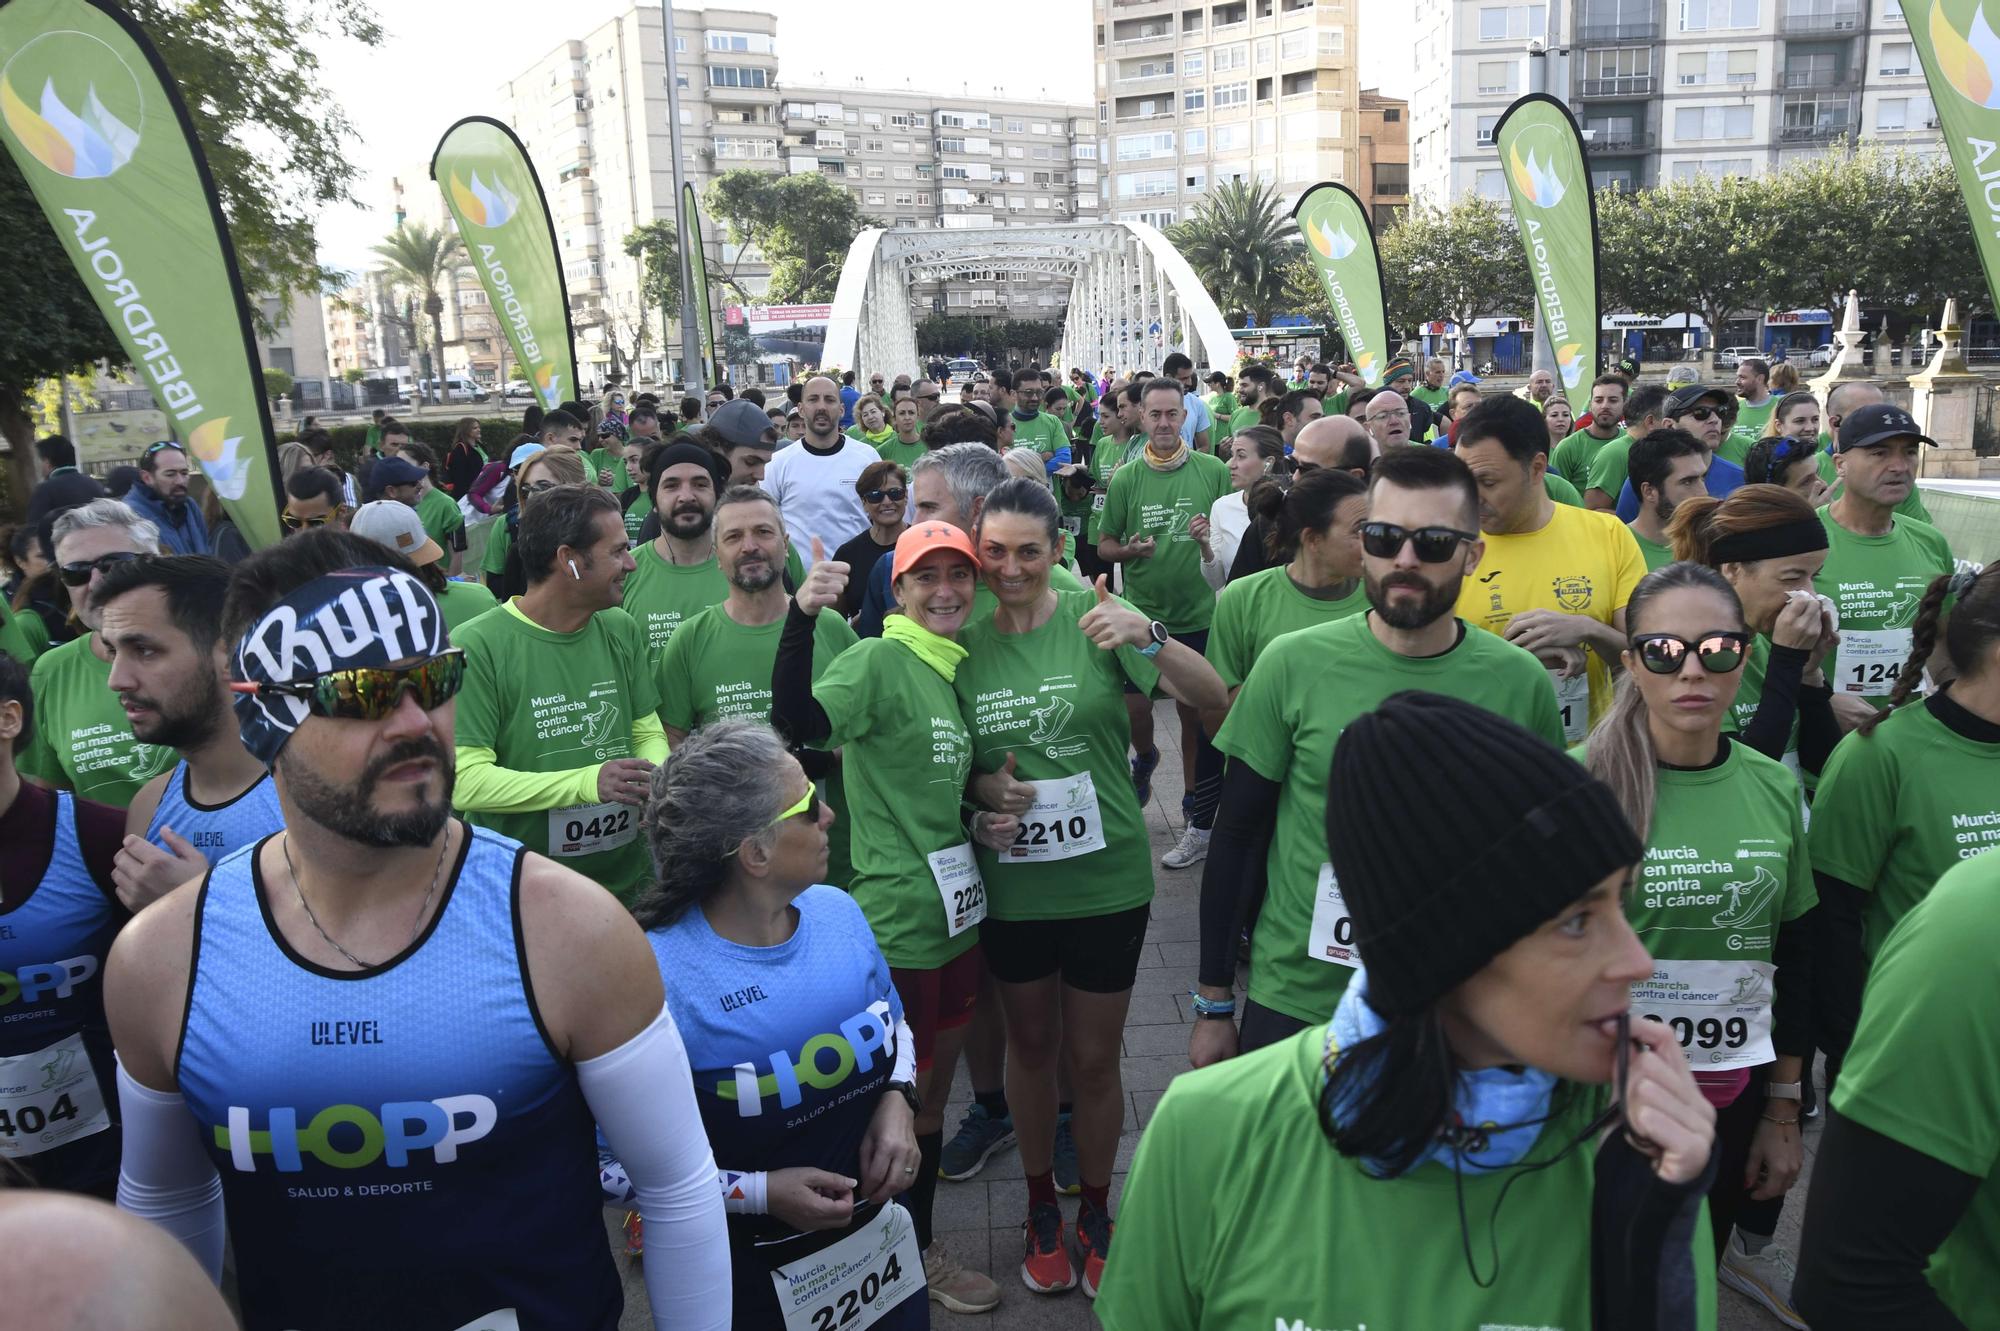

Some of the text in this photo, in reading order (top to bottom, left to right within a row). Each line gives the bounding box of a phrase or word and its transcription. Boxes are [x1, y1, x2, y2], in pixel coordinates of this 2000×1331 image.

[1839, 581, 1874, 591] Murcia
[1840, 589, 1893, 600] en marcha
[1841, 600, 1875, 609] contra
[648, 611, 681, 622] Murcia
[1841, 609, 1888, 618] el cáncer
[649, 623, 662, 631] en
[650, 640, 660, 648] el
[715, 681, 752, 694] Murcia
[531, 693, 566, 708] Murcia
[717, 689, 773, 704] en marcha
[976, 688, 1013, 703] Murcia
[533, 700, 587, 718] en marcha
[718, 702, 752, 713] contra
[976, 695, 1036, 714] en marcha
[1736, 702, 1759, 715] Mur
[536, 715, 568, 729] contra
[976, 710, 1013, 725] contra
[71, 723, 112, 740] Murcia
[537, 722, 584, 739] el cáncer
[978, 718, 1031, 736] el cáncer
[71, 741, 86, 751] en
[73, 747, 113, 763] contra
[932, 752, 946, 763] el
[76, 755, 133, 773] el cáncer
[566, 810, 629, 842] 0422
[1014, 816, 1086, 845] 2210
[1956, 832, 1978, 844] en
[1643, 845, 1699, 861] Murcia
[1643, 860, 1733, 877] en marcha
[1644, 877, 1700, 893] contra
[1644, 893, 1723, 908] el cáncer
[1647, 979, 1689, 991] marcha
[1668, 991, 1679, 1000] el
[1681, 991, 1719, 1001] cáncer
[4, 1009, 57, 1023] DEPORTE
[1642, 1014, 1747, 1049] 099
[717, 1000, 895, 1117] HOPP
[786, 1074, 886, 1129] SALUD & DEPORTE
[214, 1094, 498, 1172] HOPP
[288, 1180, 433, 1198] SALUD & DEPORTE
[789, 1263, 826, 1287] Murcia
[792, 1261, 847, 1297] en marcha
[794, 1251, 872, 1306] contra el cáncer
[811, 1252, 902, 1331] 2204
